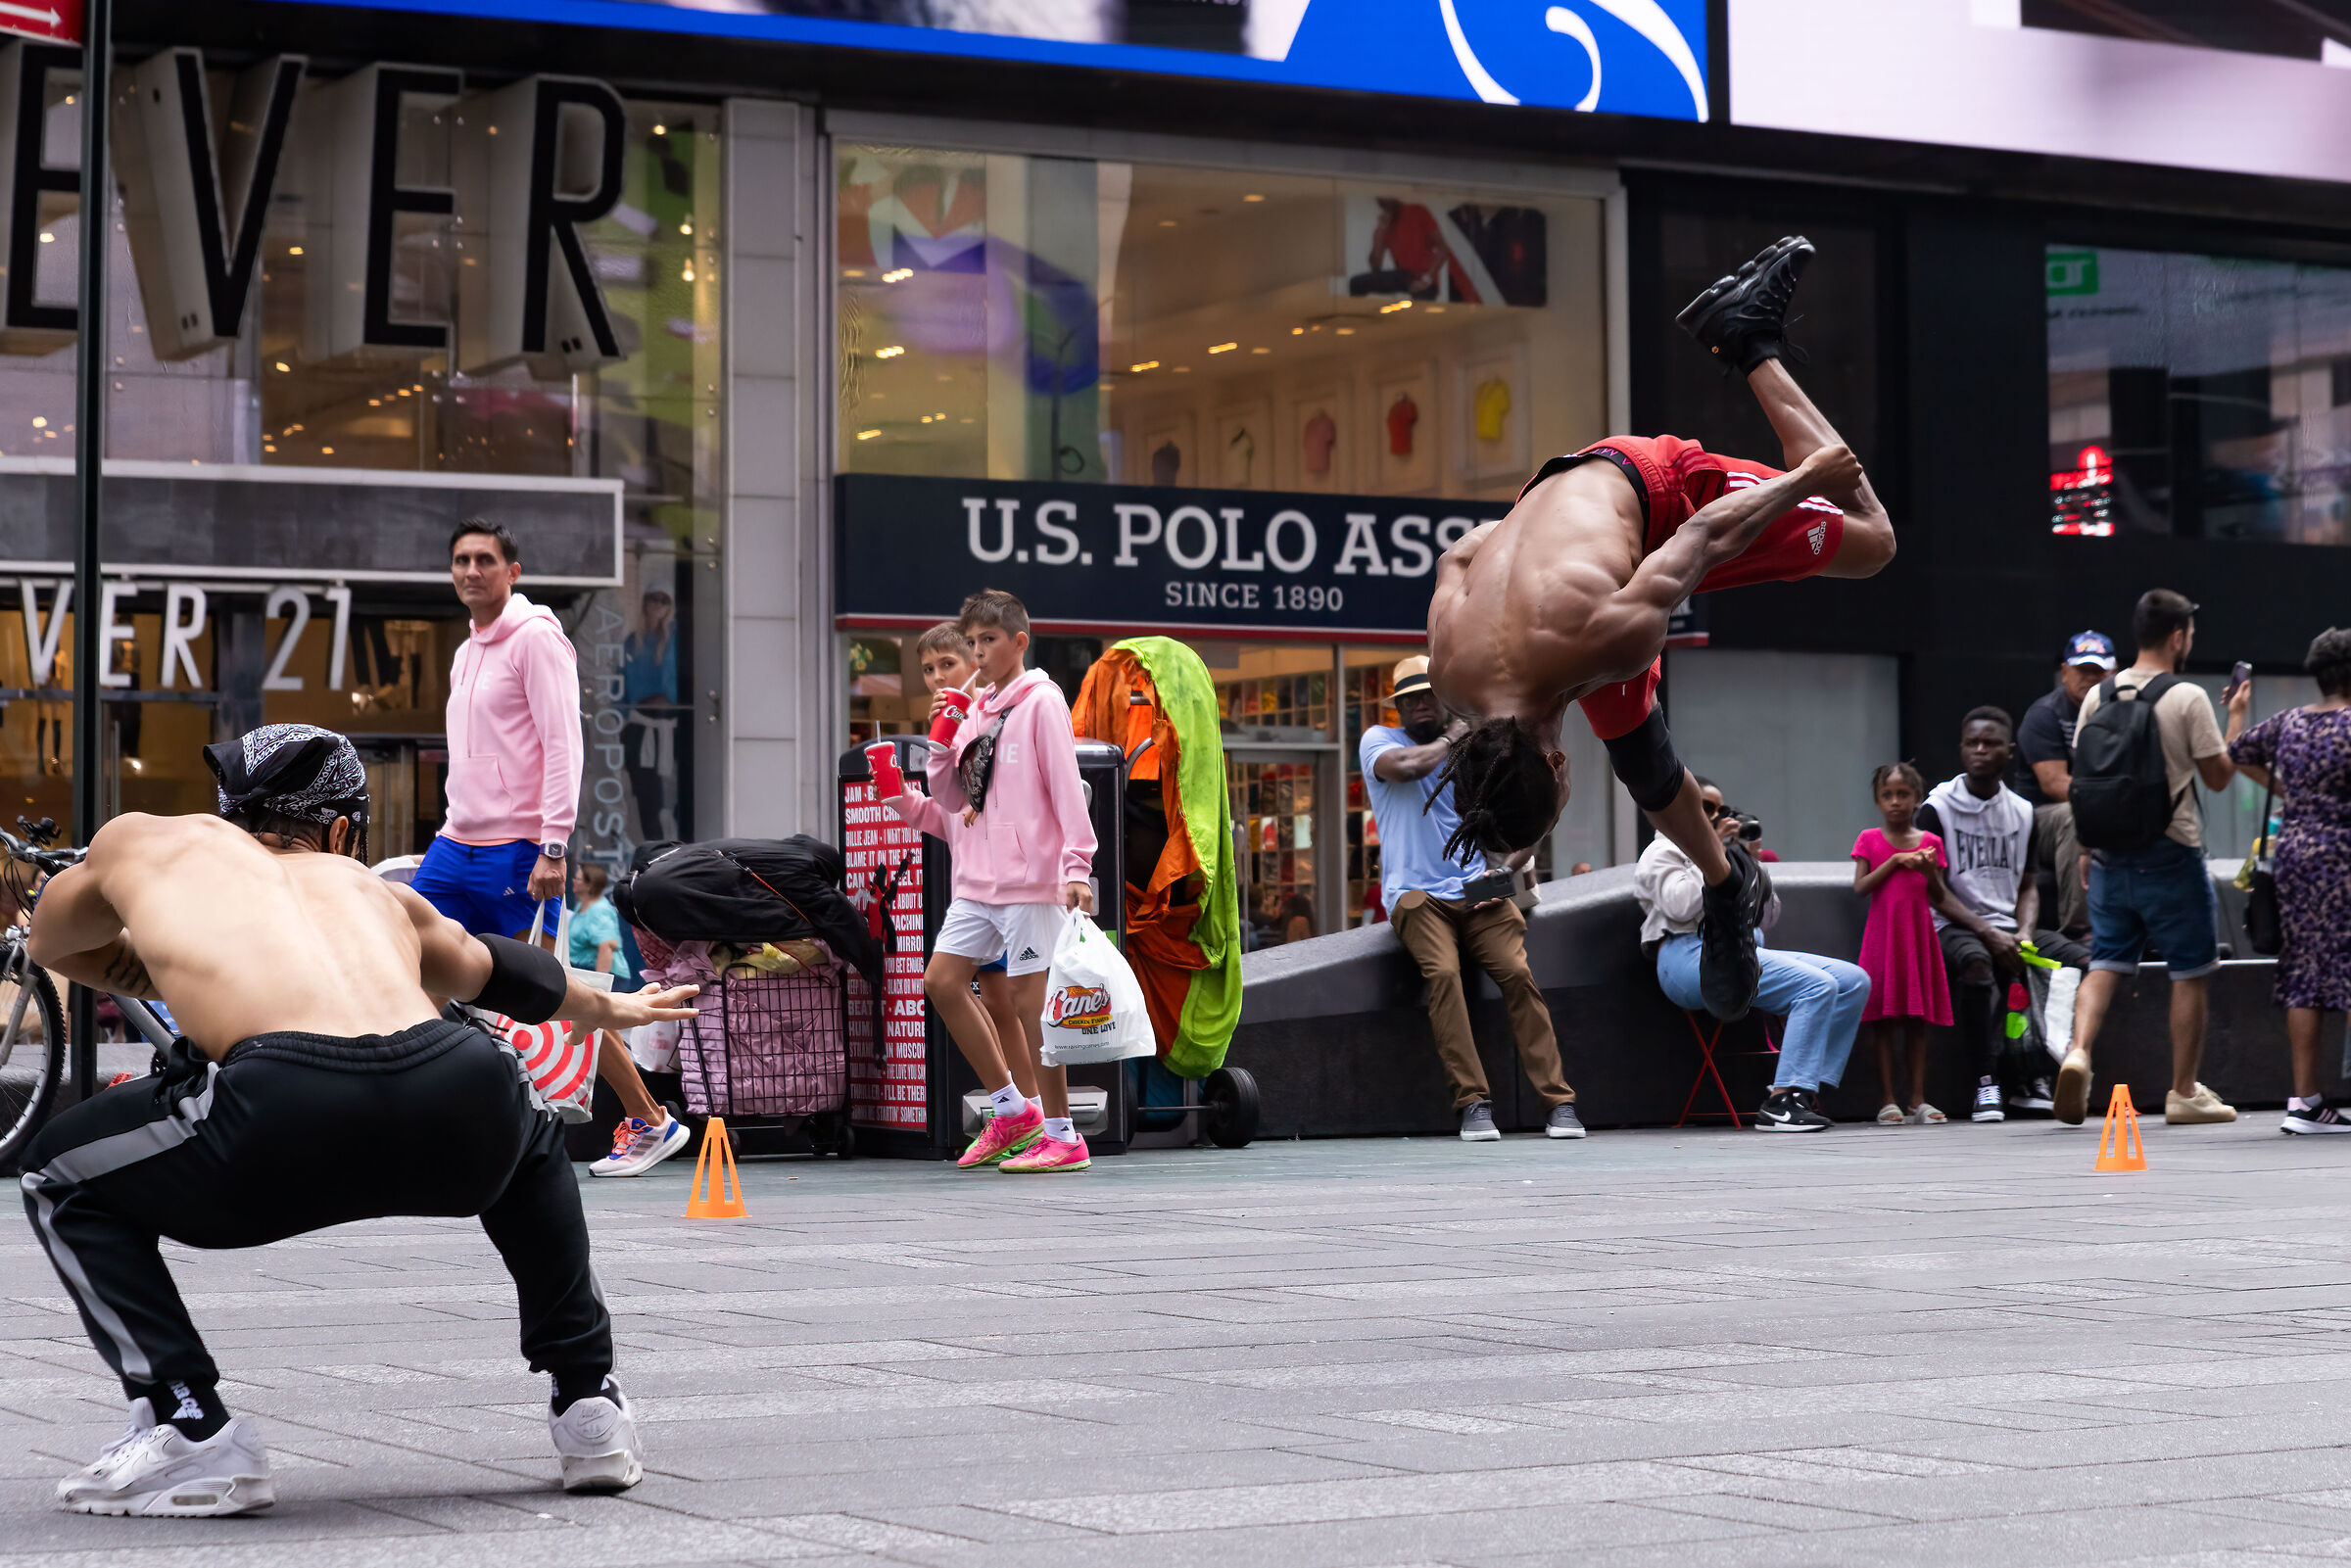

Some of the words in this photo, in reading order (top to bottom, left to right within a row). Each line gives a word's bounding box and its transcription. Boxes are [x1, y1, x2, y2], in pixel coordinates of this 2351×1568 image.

[5, 39, 627, 359] EVER
[962, 498, 1093, 566] U.S.
[1114, 503, 1319, 574] POLO
[1813, 520, 1826, 555] adidas
[1165, 581, 1260, 609] SINCE
[1273, 586, 1344, 612] 1890
[20, 578, 207, 689] VER
[262, 585, 352, 691] 21
[845, 785, 862, 803] JAM
[845, 805, 882, 825] SMOOTH
[864, 830, 878, 845] JEAN
[845, 850, 867, 868] BLAME
[869, 851, 876, 866] IT
[878, 849, 887, 866] ON
[888, 849, 901, 865] THE
[846, 873, 865, 888] CAN
[897, 893, 916, 909] ABOUT
[895, 958, 906, 973] GET
[894, 1000, 926, 1017] ABC
[1046, 983, 1111, 1027] Cane's
[896, 1085, 906, 1101] BE
